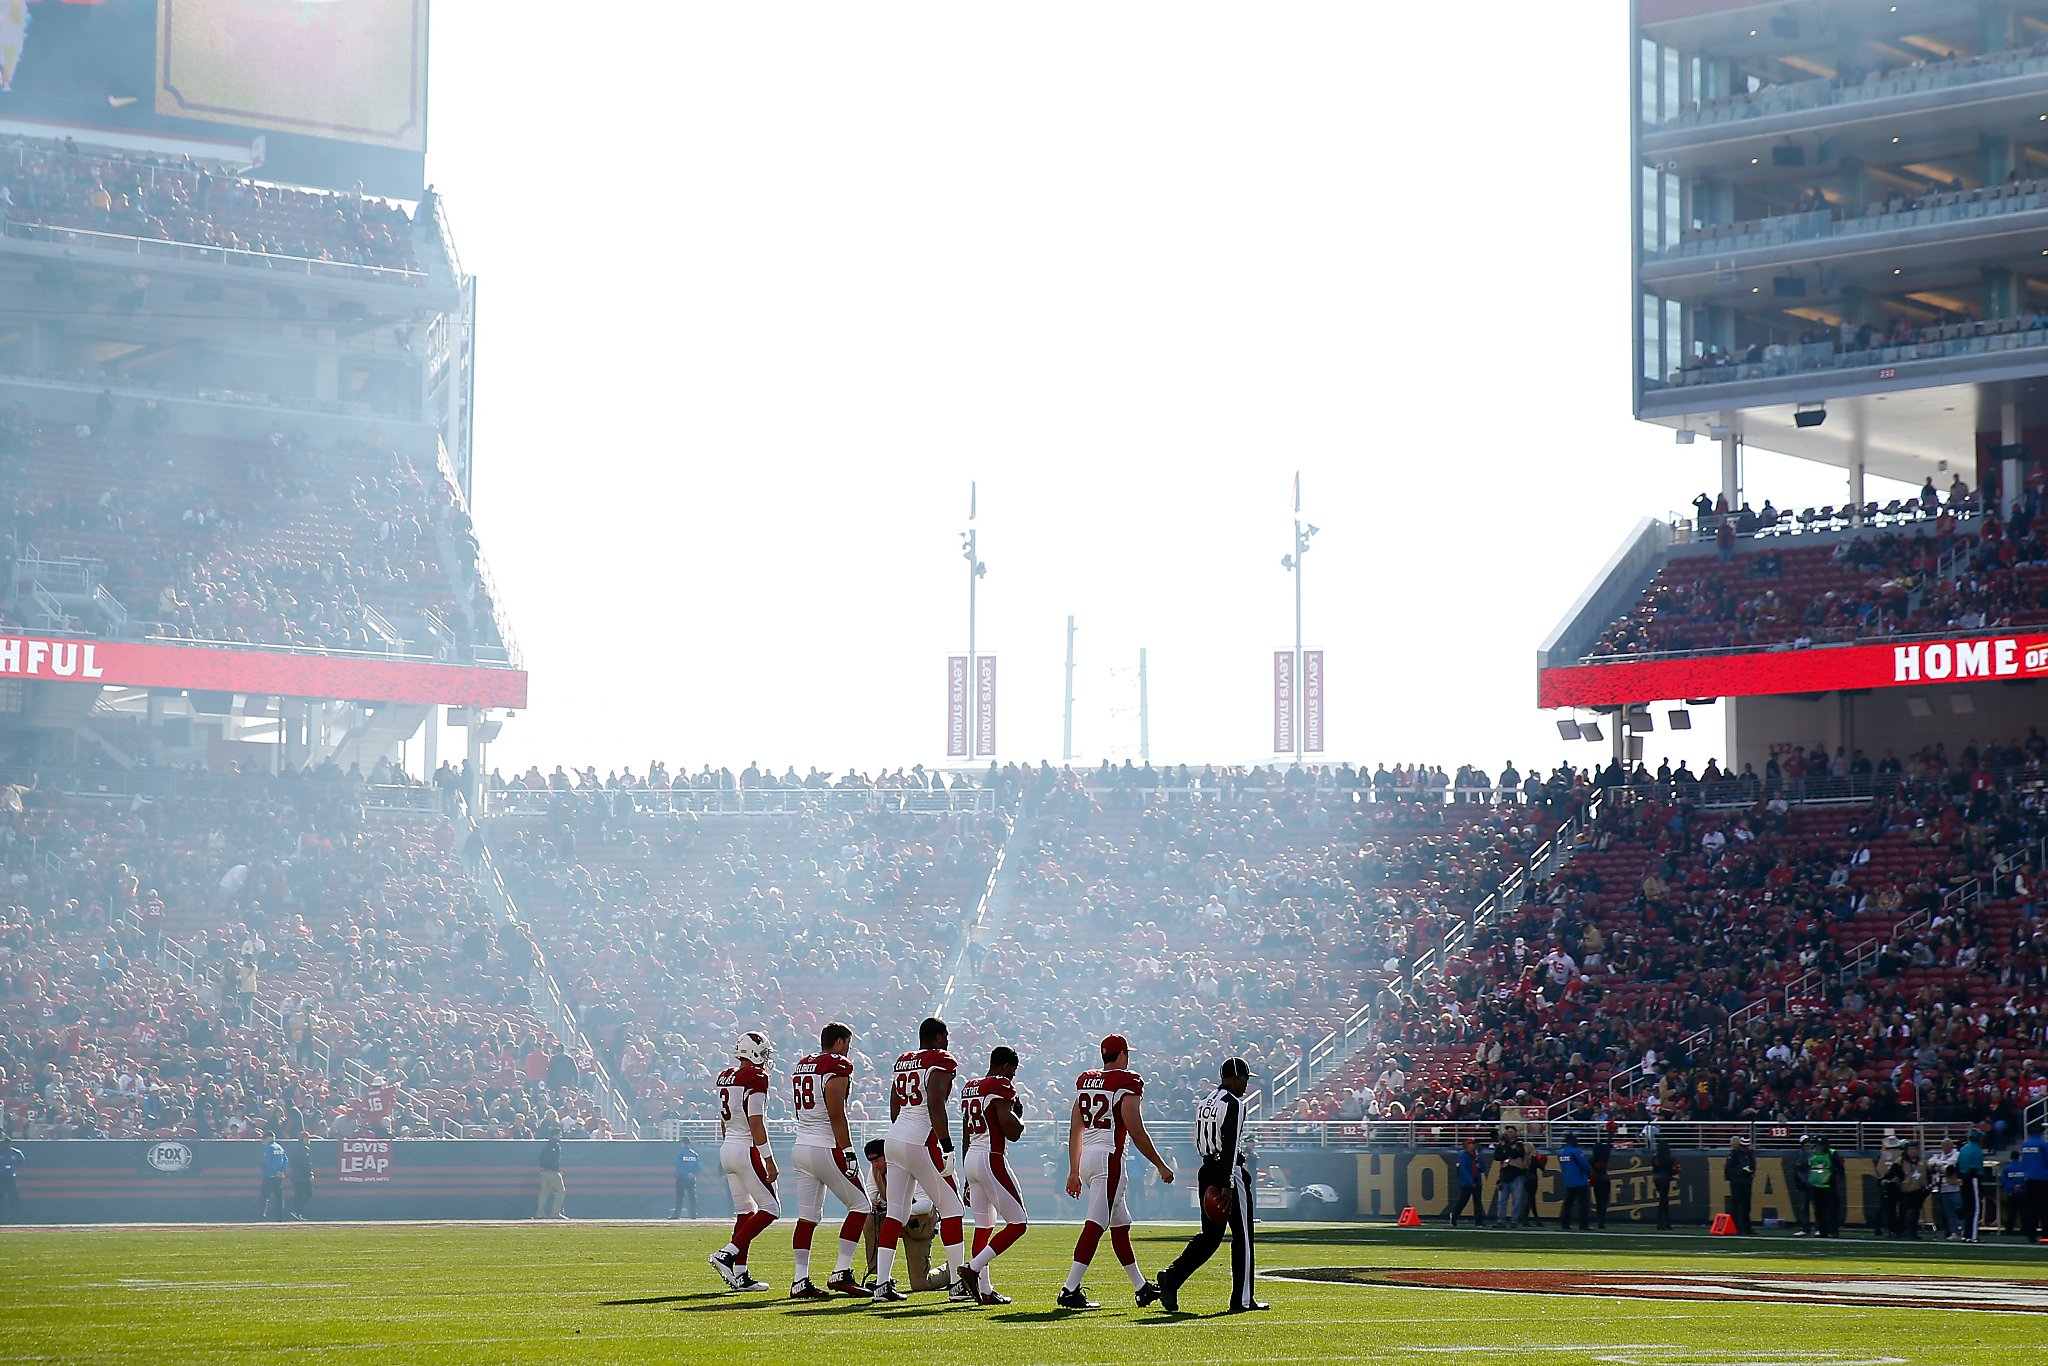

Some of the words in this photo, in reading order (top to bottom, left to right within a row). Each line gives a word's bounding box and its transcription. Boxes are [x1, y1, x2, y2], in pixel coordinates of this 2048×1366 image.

[0, 639, 104, 678] HFUL
[1894, 639, 2019, 682] HOME
[2025, 649, 2048, 669] OF
[952, 704, 963, 753] STADIUM
[981, 704, 992, 753] STADIUM
[1279, 699, 1289, 751] STADIUM
[1308, 699, 1319, 750] STADIUM
[895, 1058, 922, 1071] CAMPBELL
[793, 1075, 816, 1111] 68
[897, 1071, 924, 1107] 93
[1082, 1078, 1105, 1089] LEACH
[368, 1097, 384, 1112] 16
[719, 1088, 731, 1121] 3
[1078, 1092, 1113, 1130] 82
[1198, 1106, 1218, 1120] 104
[783, 1125, 798, 1134] 130
[1343, 1127, 1356, 1135] 132
[1771, 1127, 1788, 1137] 133
[157, 1147, 182, 1160] FOX
[341, 1155, 389, 1173] LEAP
